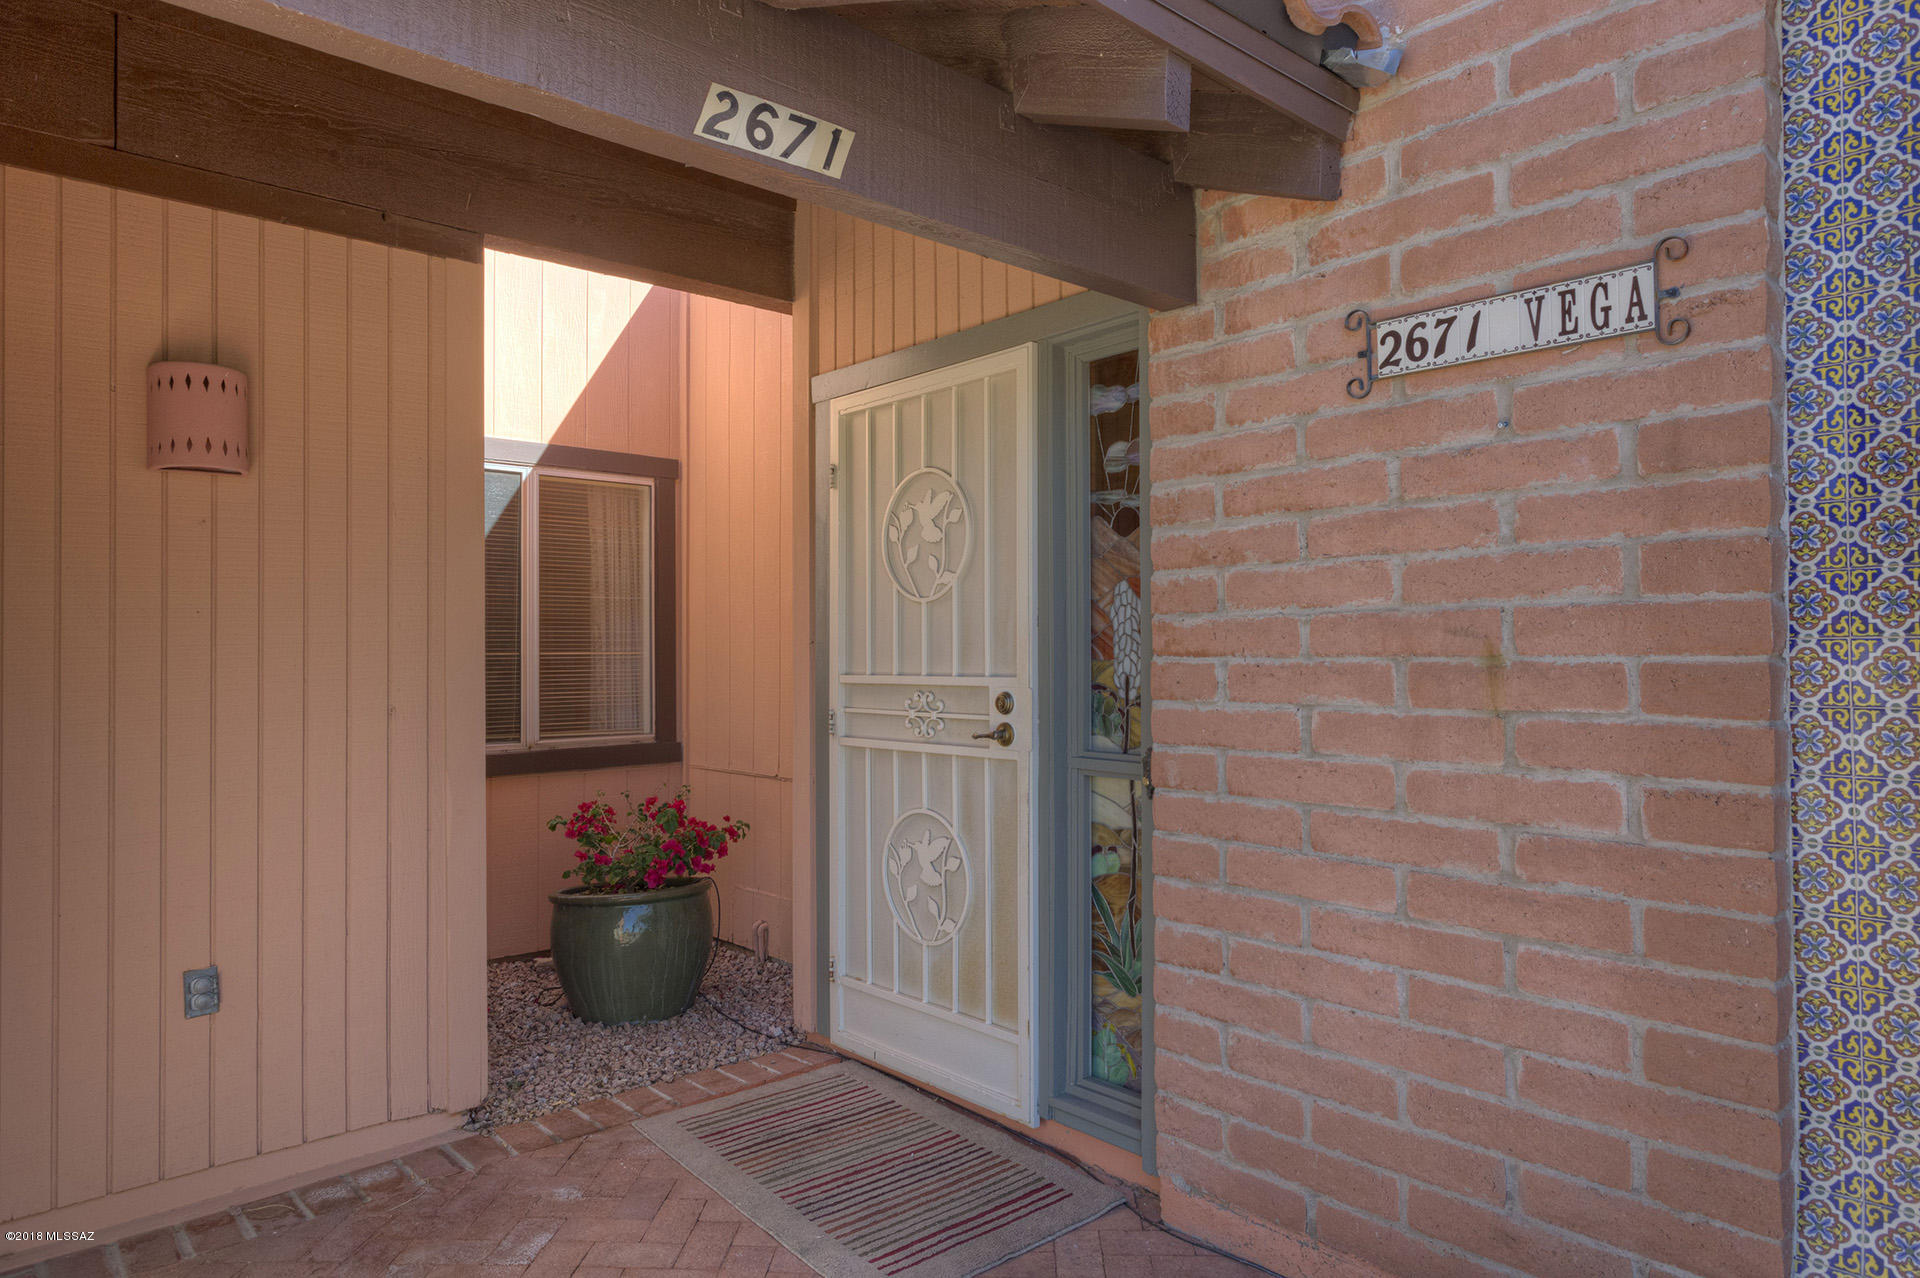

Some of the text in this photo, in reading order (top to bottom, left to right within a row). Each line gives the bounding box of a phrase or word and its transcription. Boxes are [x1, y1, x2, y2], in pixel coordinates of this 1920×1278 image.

[701, 90, 842, 171] 2671
[1379, 276, 1648, 370] 2671 VEGA
